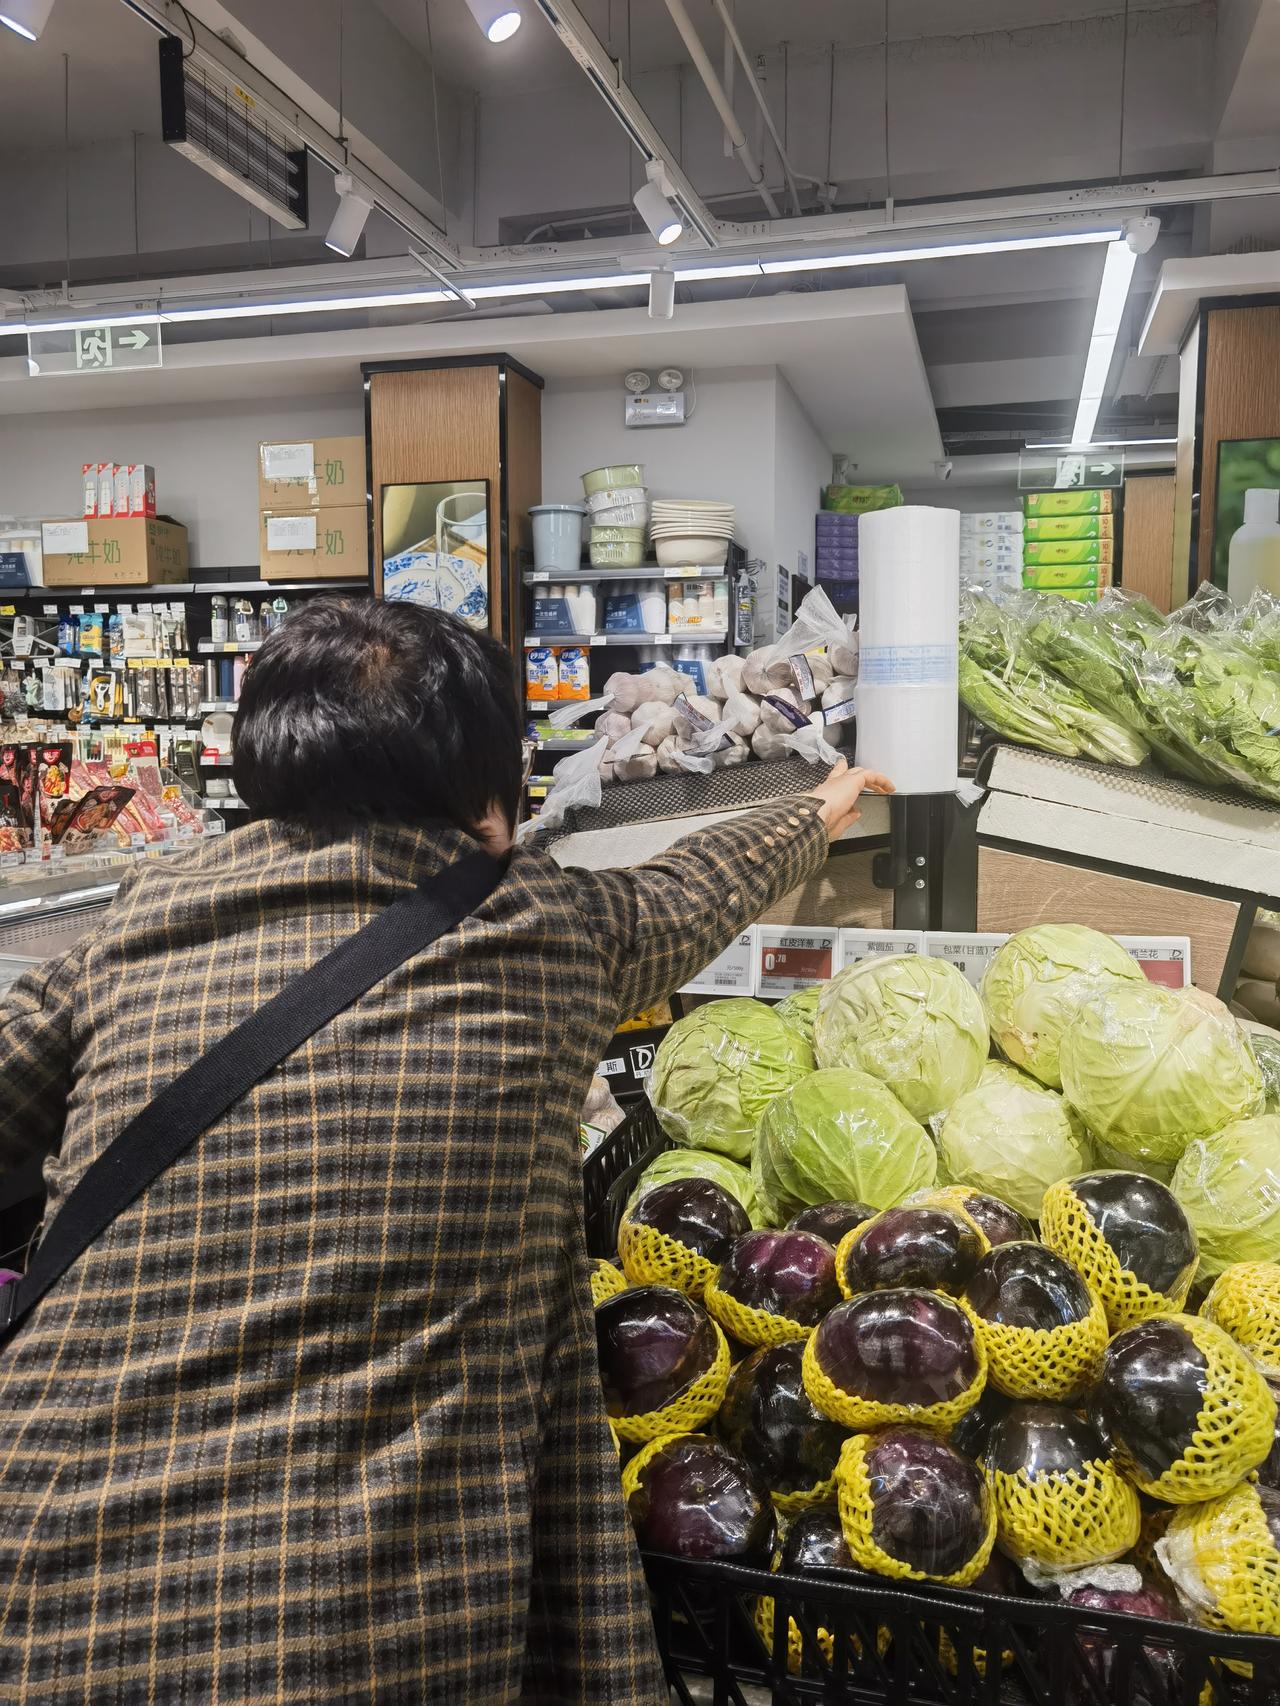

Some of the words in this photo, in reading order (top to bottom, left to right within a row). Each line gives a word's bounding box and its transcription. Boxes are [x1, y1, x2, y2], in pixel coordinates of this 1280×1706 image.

[780, 938, 814, 948] 红皮洋葱
[867, 942, 894, 951] 紫圆茄
[1129, 949, 1158, 959] 西兰花
